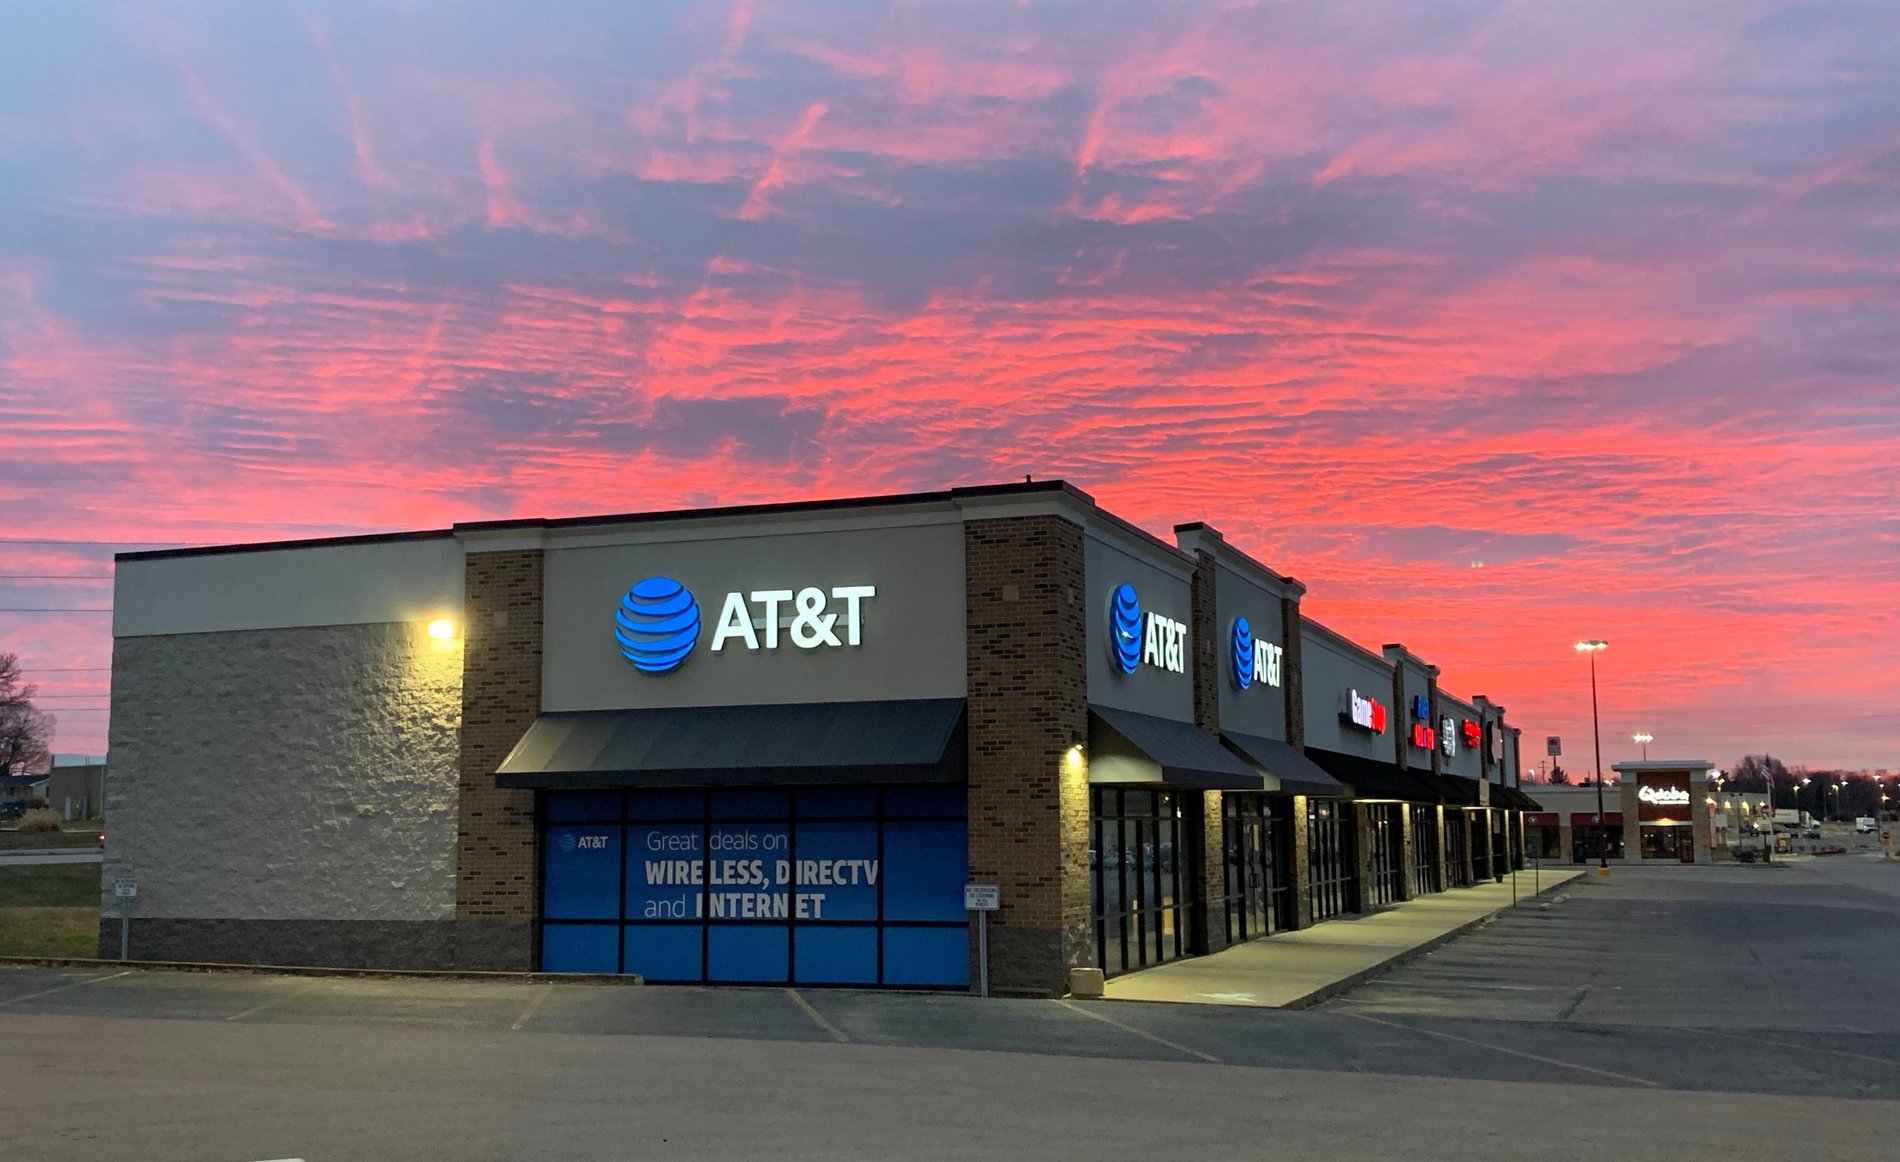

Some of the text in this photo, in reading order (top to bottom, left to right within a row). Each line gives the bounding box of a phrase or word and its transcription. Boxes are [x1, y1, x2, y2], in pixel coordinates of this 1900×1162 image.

[711, 585, 876, 652] AT&T
[1143, 611, 1187, 674] AT&T
[1252, 638, 1283, 688] AT&T
[577, 835, 609, 849] AT&T
[646, 828, 789, 851] Great deals on
[644, 859, 879, 890] WIRELESS, DIRECTV
[644, 892, 826, 919] and INTERNET
